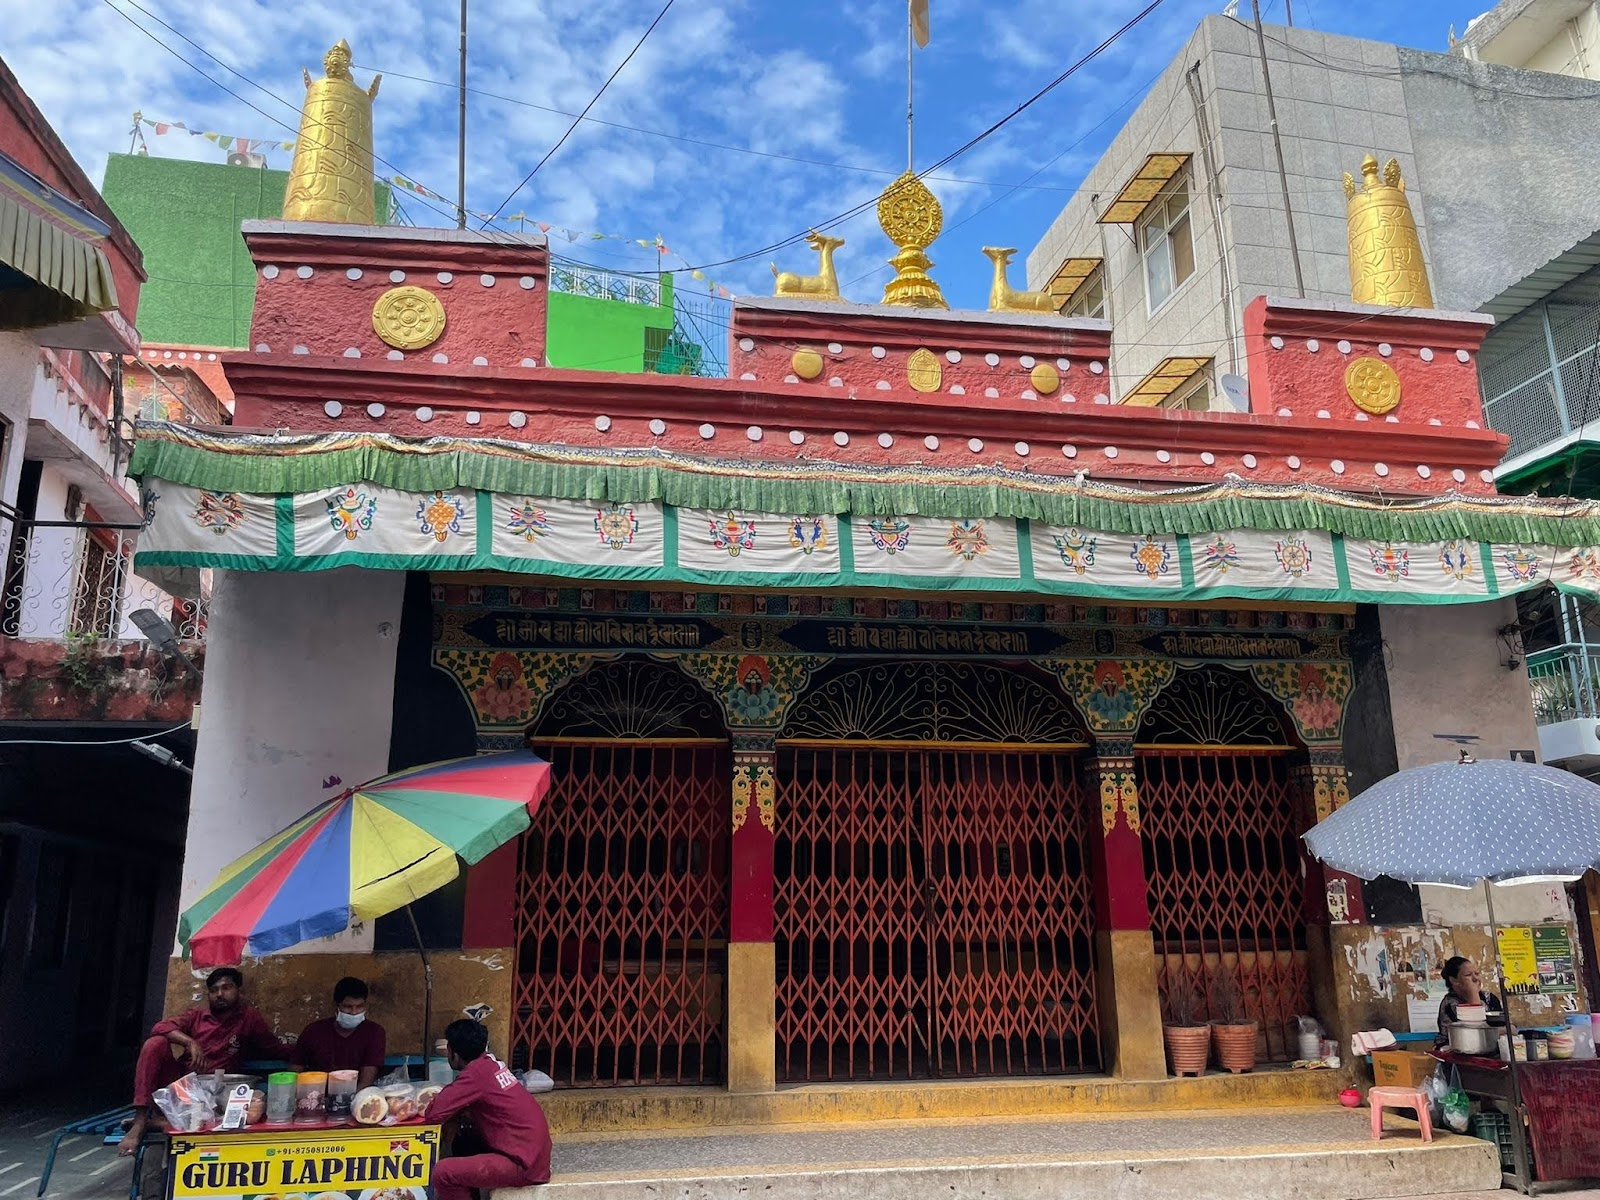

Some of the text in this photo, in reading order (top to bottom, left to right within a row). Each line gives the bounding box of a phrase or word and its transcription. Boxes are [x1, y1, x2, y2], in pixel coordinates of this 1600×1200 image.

[277, 1146, 345, 1155] +91-8750812006
[182, 1153, 424, 1188] GURU LAPHING
